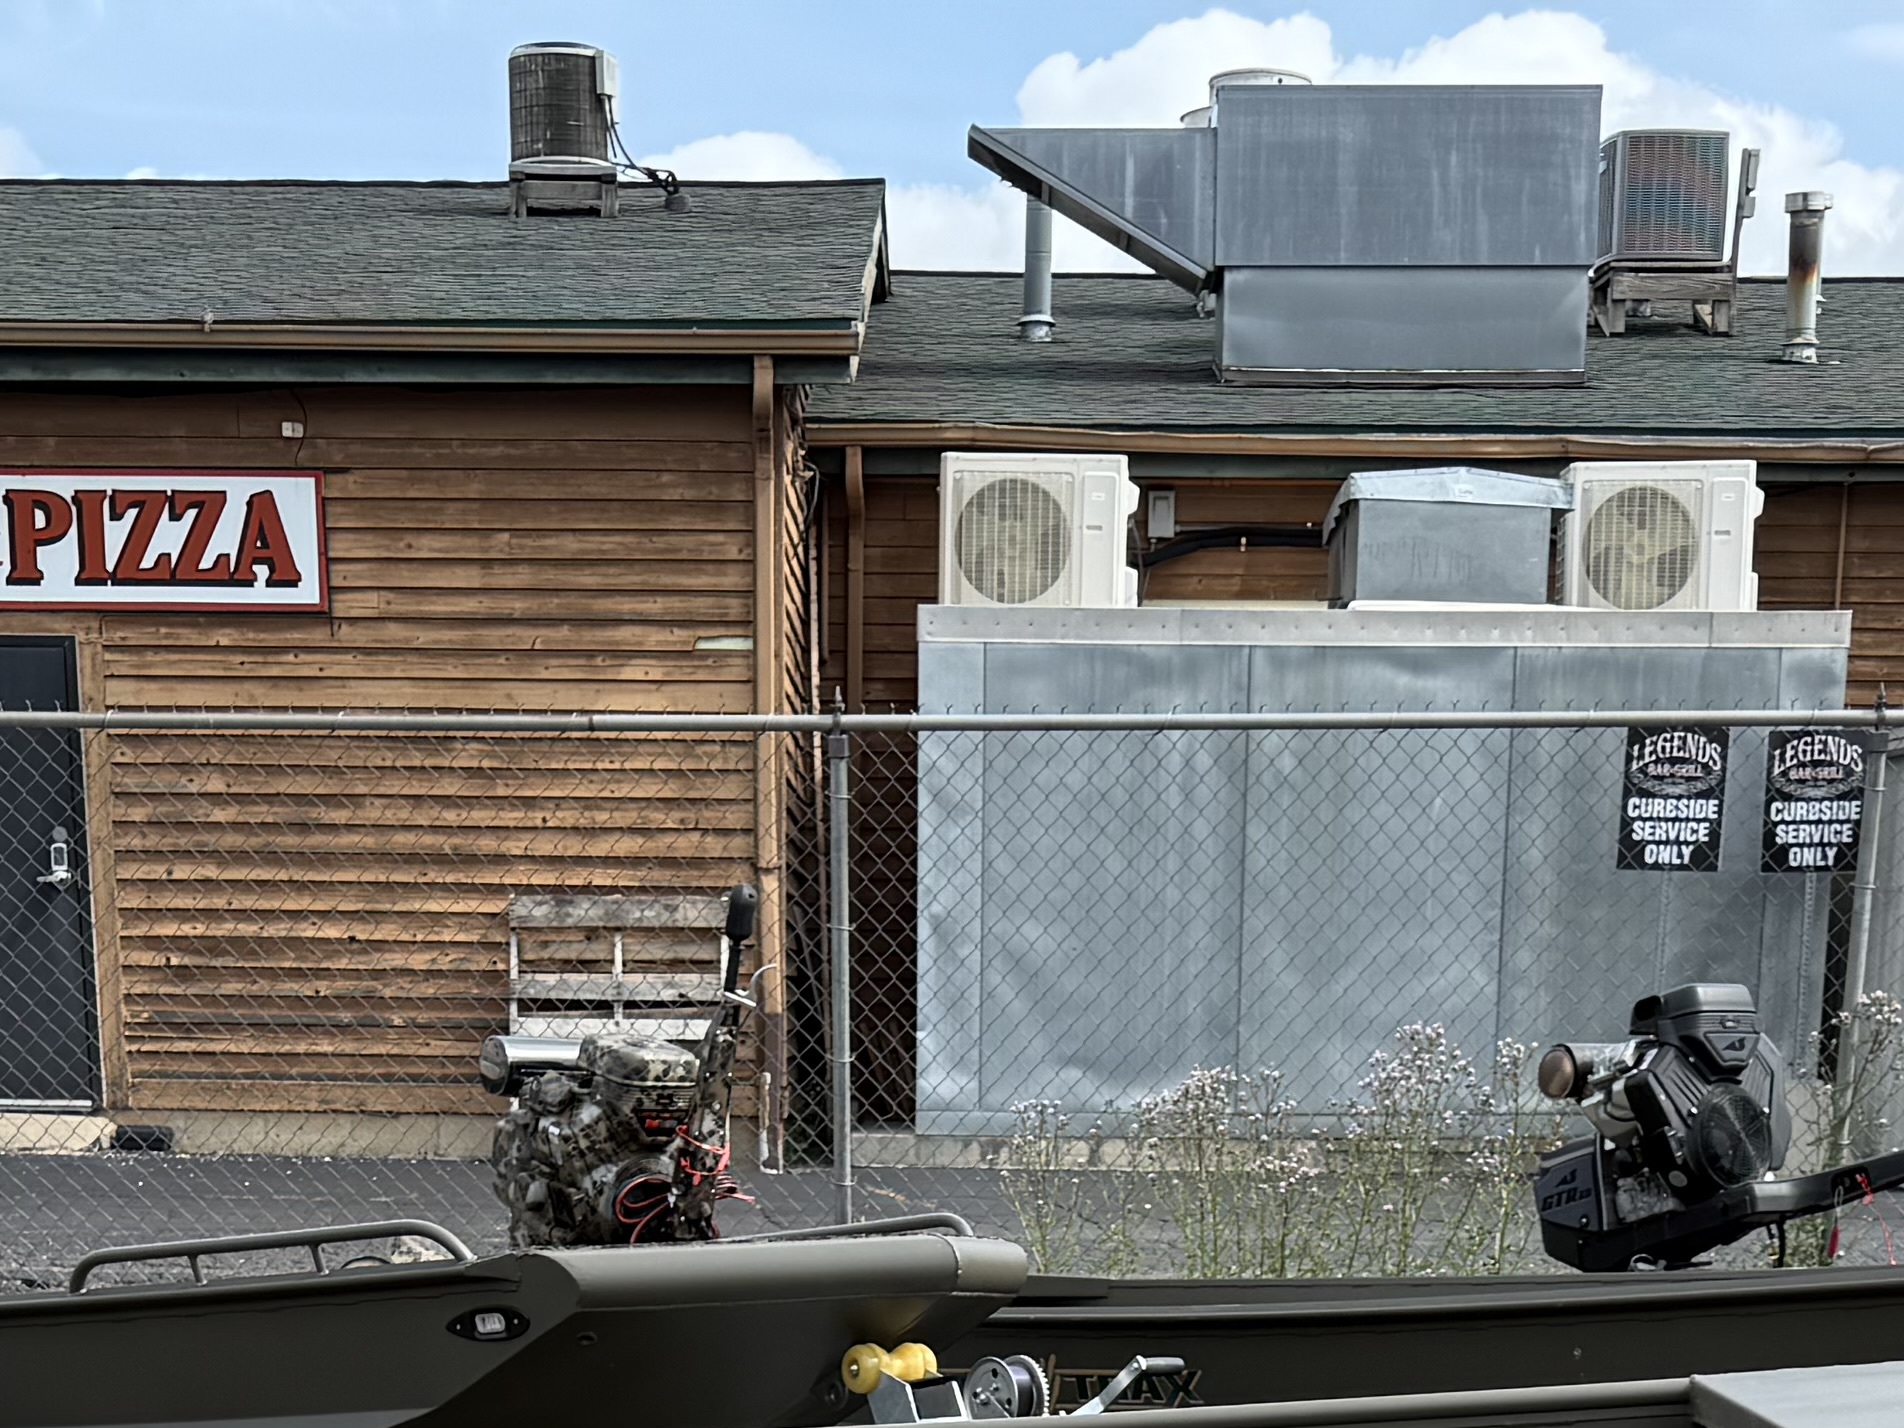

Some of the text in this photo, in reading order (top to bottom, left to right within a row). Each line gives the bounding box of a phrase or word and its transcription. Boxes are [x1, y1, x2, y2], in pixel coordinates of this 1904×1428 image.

[1629, 731, 1722, 772] LEGENDS
[1772, 735, 1863, 776] LEGENDS
[1626, 797, 1719, 820] CURBSIDE
[1769, 800, 1862, 822] CURBSIDE
[1631, 820, 1710, 843] SERVICE
[1775, 823, 1853, 845] SERVICE
[1644, 844, 1695, 866] ONLY
[1788, 846, 1839, 868] ONLY
